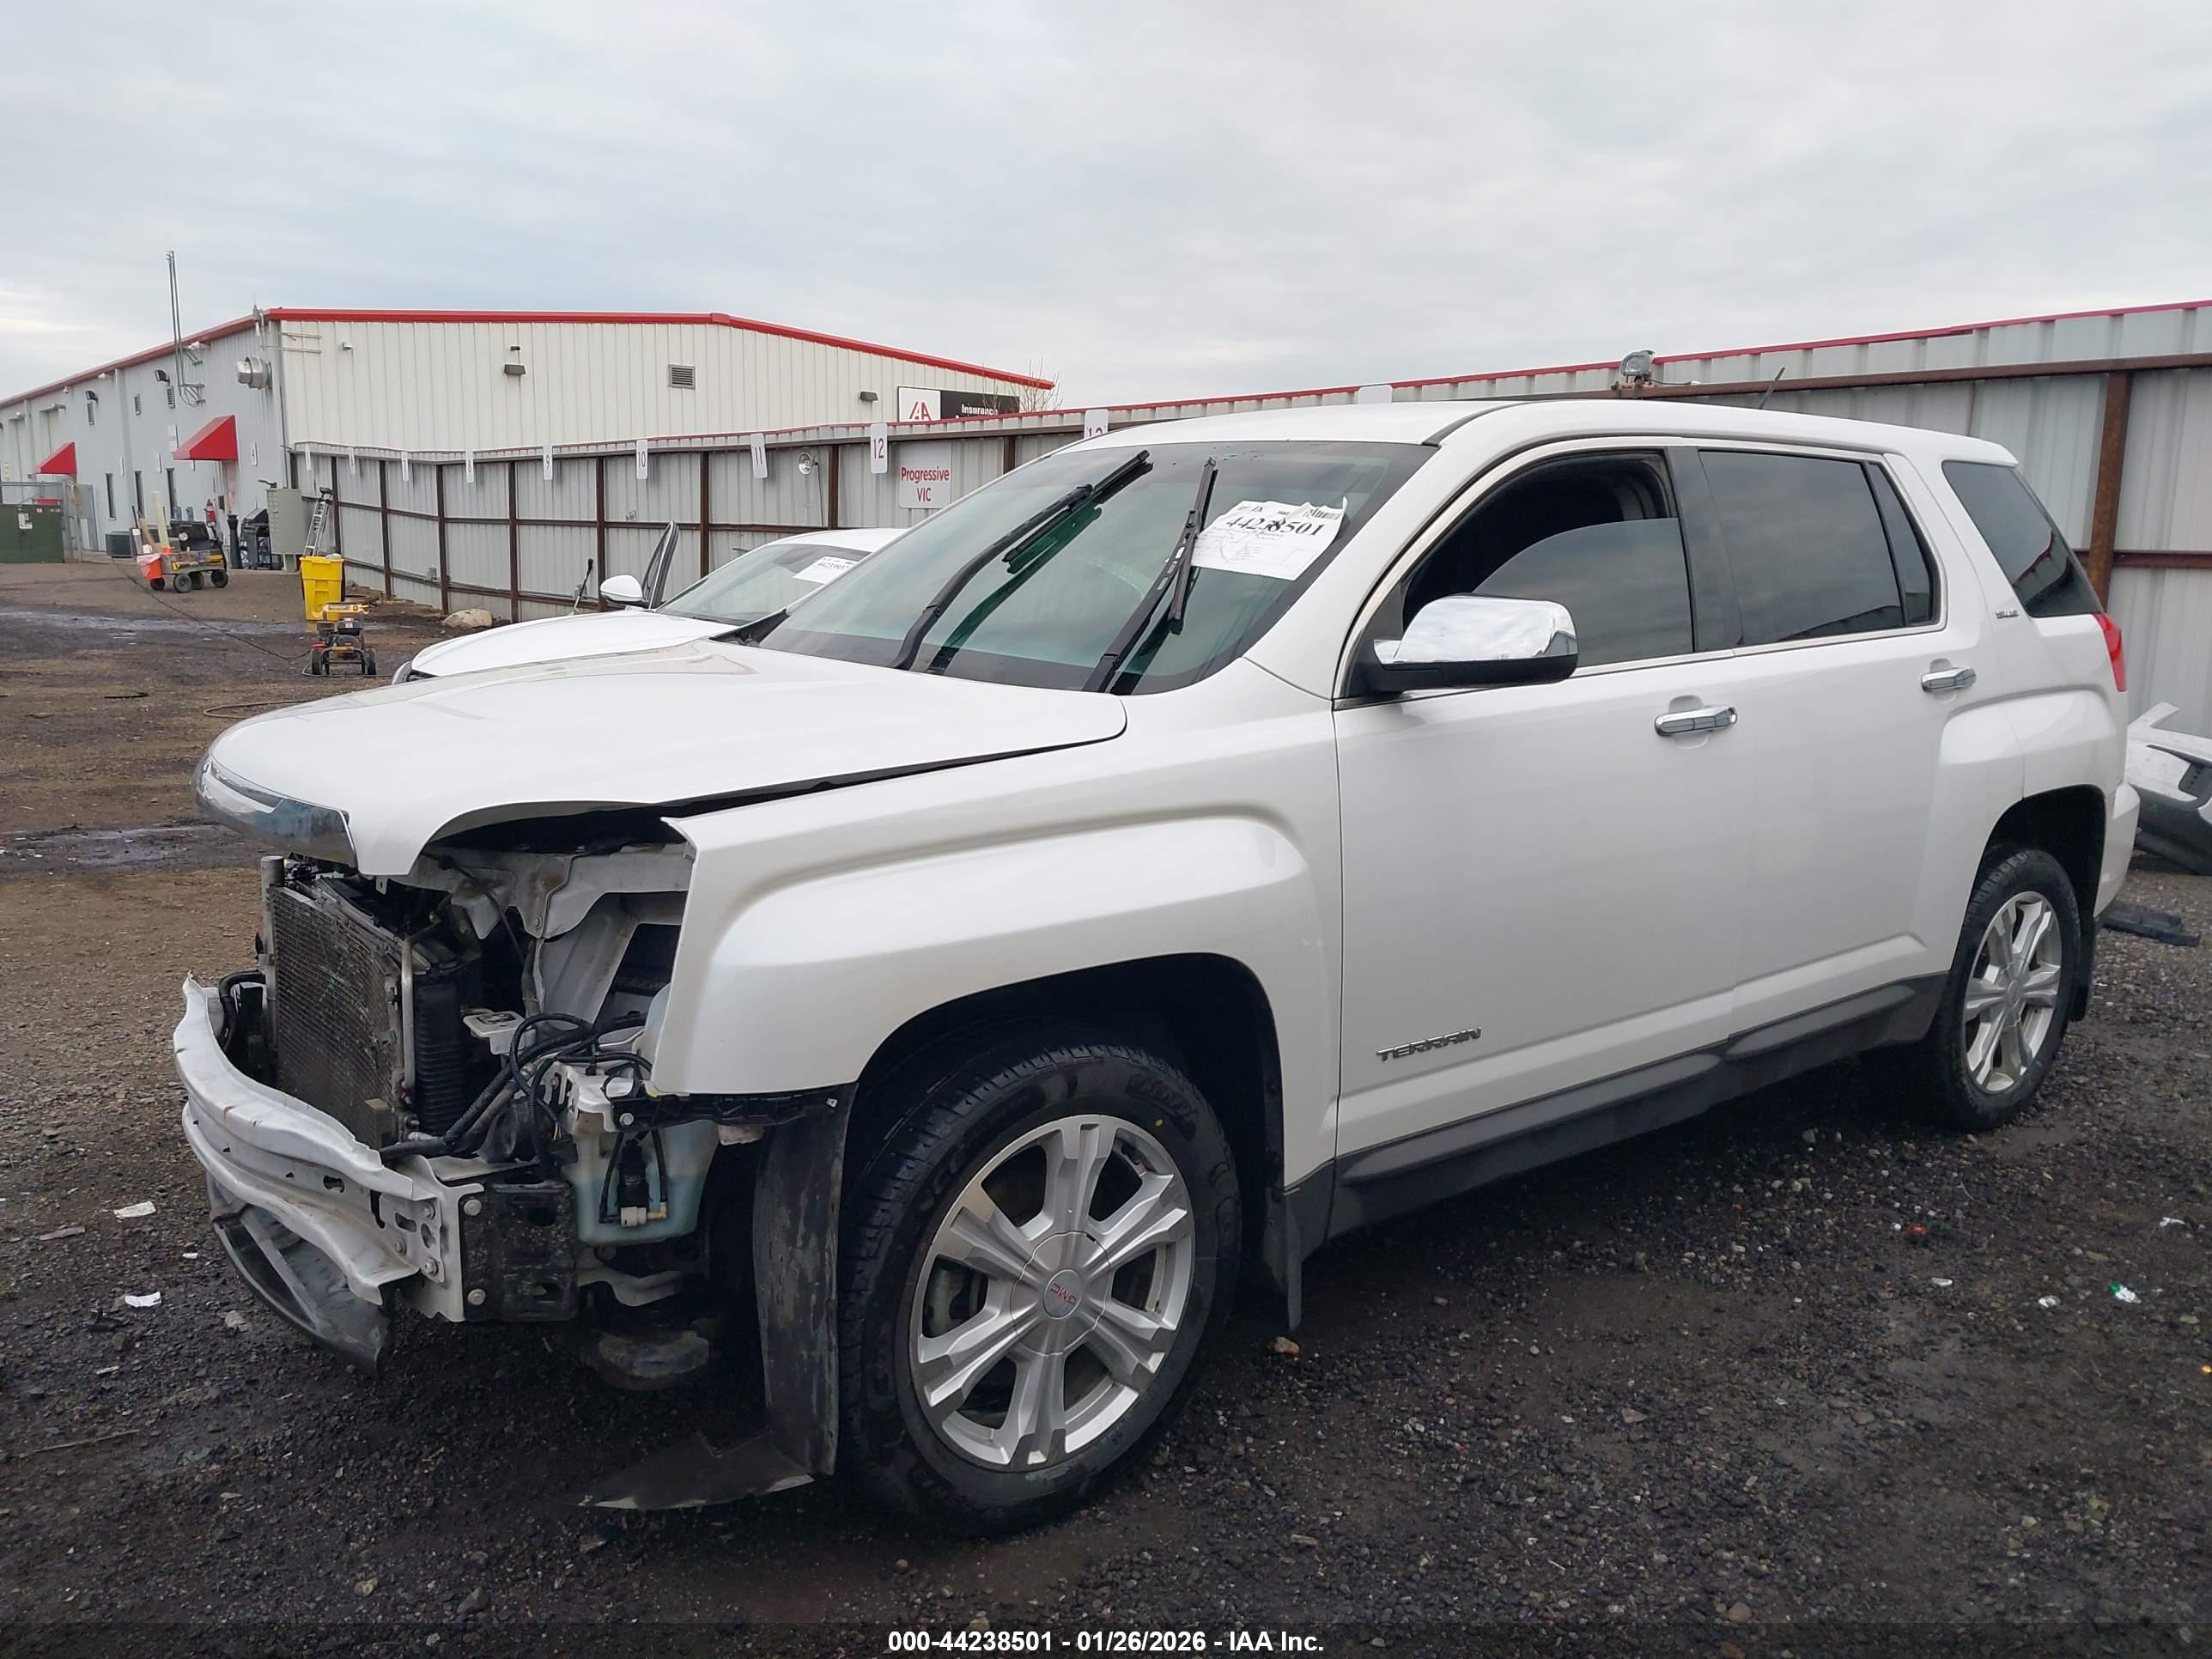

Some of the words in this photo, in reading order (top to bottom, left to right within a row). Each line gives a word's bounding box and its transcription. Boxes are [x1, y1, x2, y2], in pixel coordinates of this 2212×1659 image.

[752, 446, 763, 465] 11
[872, 438, 884, 459] 12
[545, 454, 550, 470] 9
[638, 451, 647, 468] 10
[901, 466, 950, 483] Progressive
[916, 487, 932, 502] VIC
[1376, 1027, 1482, 1062] TERRAIN
[1050, 1282, 1077, 1305] GMC
